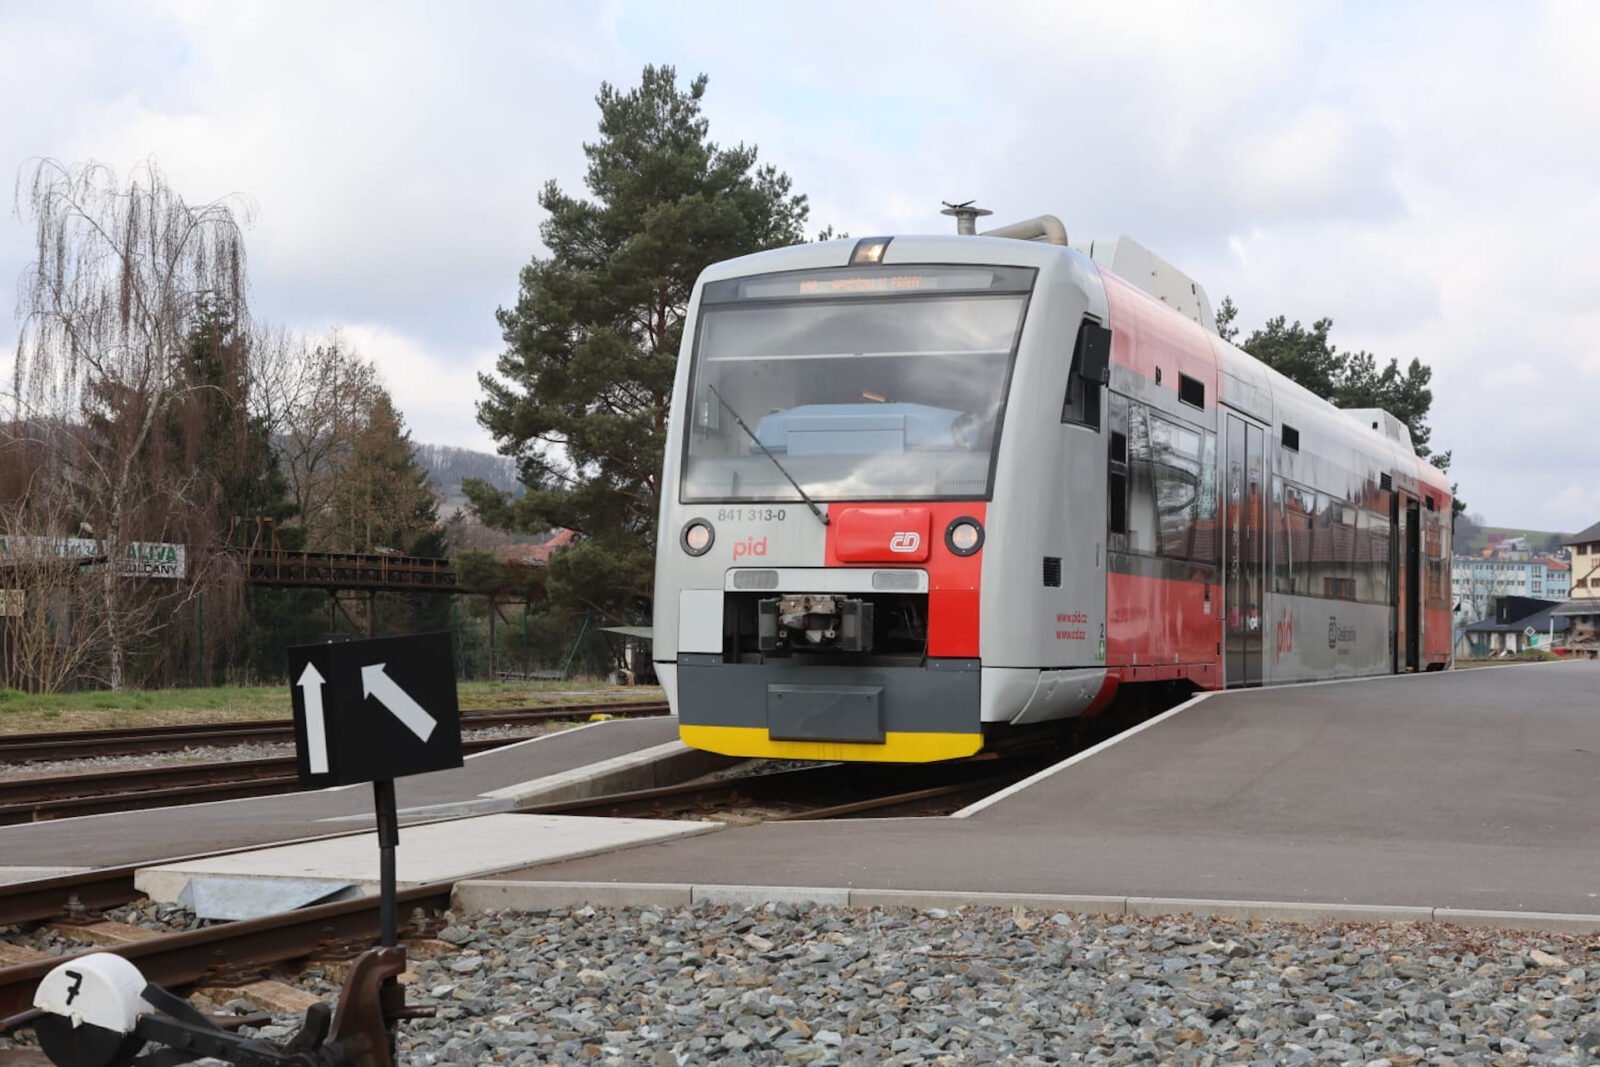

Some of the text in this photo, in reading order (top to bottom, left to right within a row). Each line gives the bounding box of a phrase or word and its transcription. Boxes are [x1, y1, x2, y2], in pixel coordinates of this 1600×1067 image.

[717, 508, 786, 522] 841 313-0
[126, 545, 177, 560] ALIVA
[733, 536, 767, 561] pid
[1099, 622, 1105, 639] 2
[1275, 607, 1293, 664] pid
[65, 970, 83, 1006] 7
